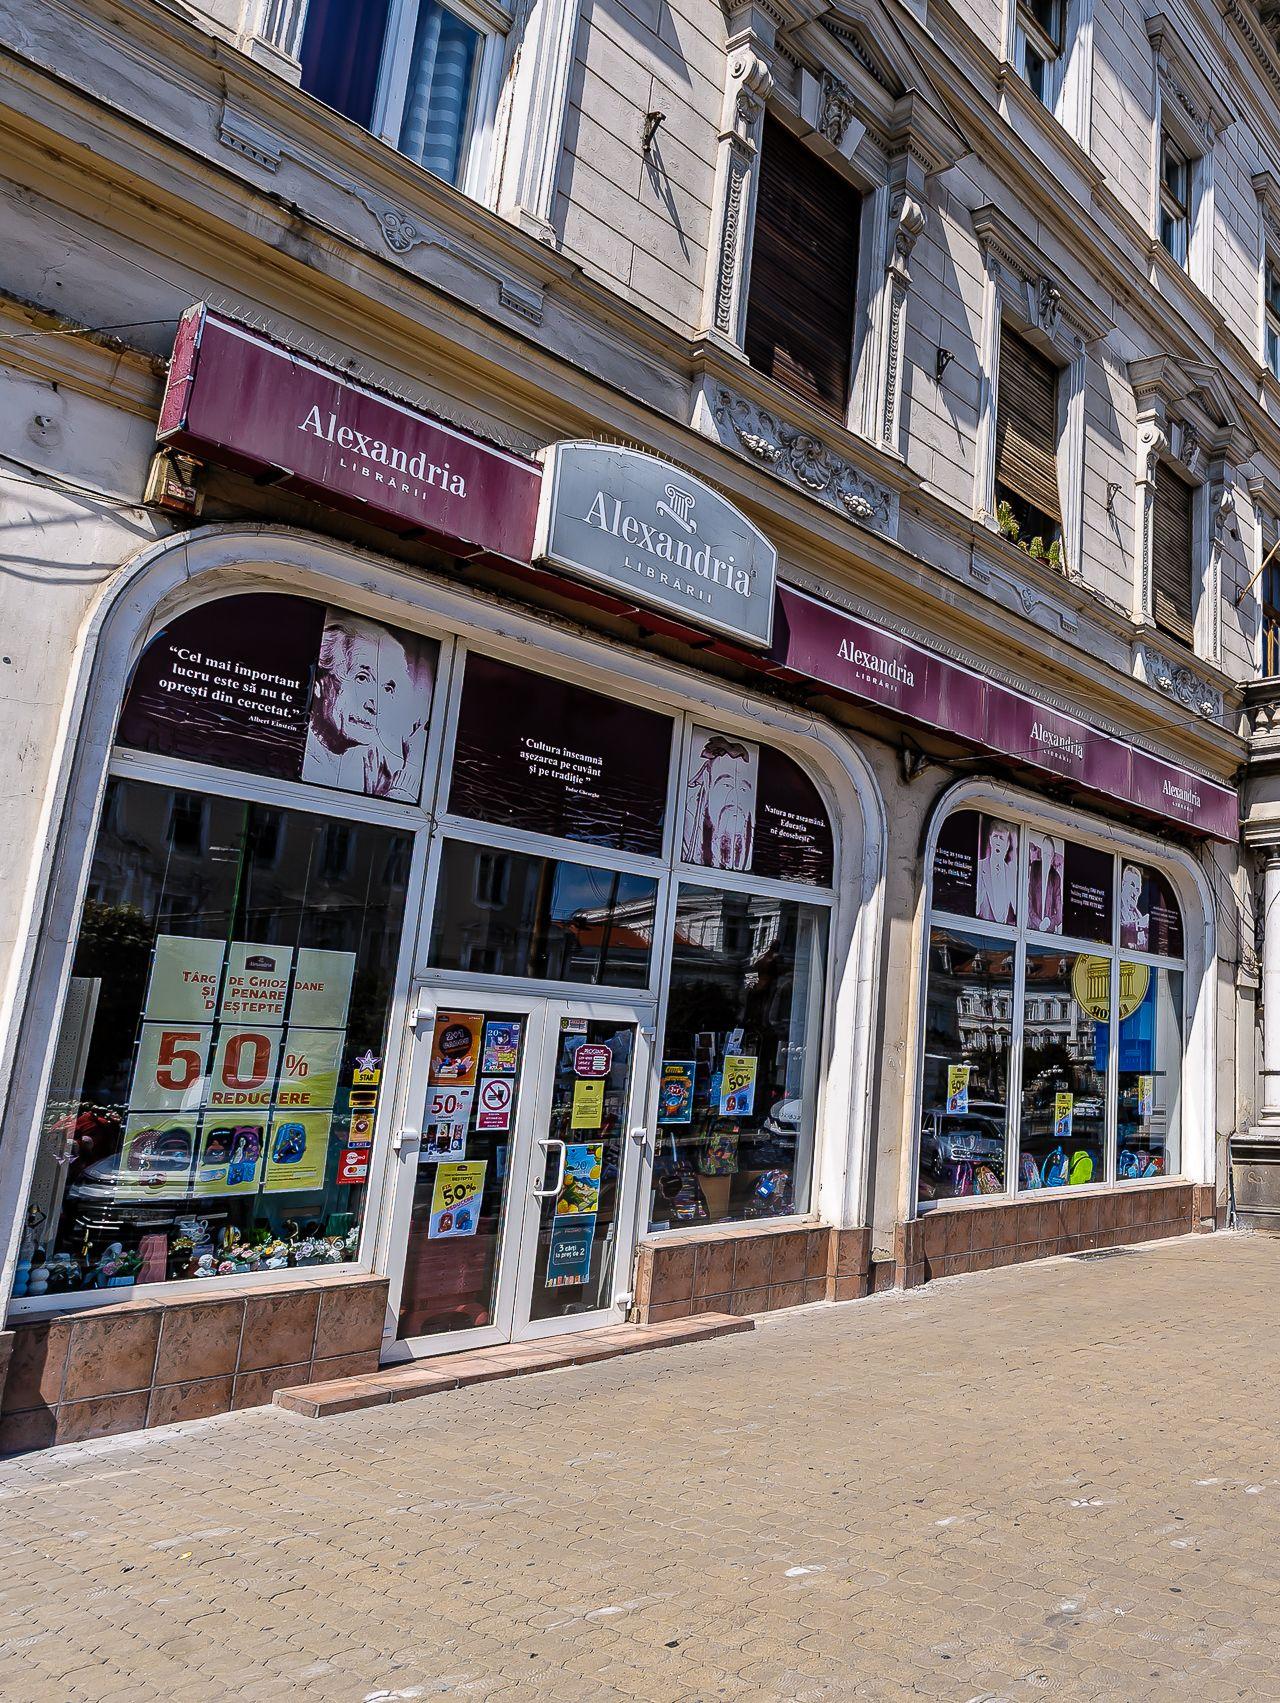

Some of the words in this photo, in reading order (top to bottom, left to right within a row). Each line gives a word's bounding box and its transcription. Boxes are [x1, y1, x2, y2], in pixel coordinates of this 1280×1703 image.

[297, 405, 468, 498] Alexandria
[339, 458, 427, 500] LIBRĂRII
[582, 491, 751, 597] Alexandria
[624, 556, 712, 604] LIBRĂRII
[205, 657, 231, 671] mai
[234, 663, 301, 689] important
[836, 638, 915, 687] Alexandria
[159, 679, 208, 697] oprești
[211, 690, 233, 704] din
[172, 663, 209, 682] lucru
[213, 676, 240, 689] este
[242, 683, 257, 694] să
[260, 688, 277, 699] nu
[281, 691, 293, 703] te
[248, 715, 270, 725] Albert
[271, 720, 297, 732] Einstein
[526, 738, 561, 754] Cultura
[1030, 721, 1083, 759] Alexandria
[538, 767, 550, 776] pe
[560, 761, 571, 769] pe
[572, 765, 601, 776] cuvânt
[1162, 779, 1201, 808] Alexandria
[182, 971, 217, 984] TÂRG
[229, 976, 244, 986] DE
[201, 987, 214, 999] ȘI
[232, 988, 286, 1000] PENARE
[359, 1073, 374, 1081] STAR
[431, 1094, 463, 1114] 50%
[443, 1183, 477, 1207] 50%
[559, 1244, 564, 1252] 3
[580, 1247, 586, 1256] 2
